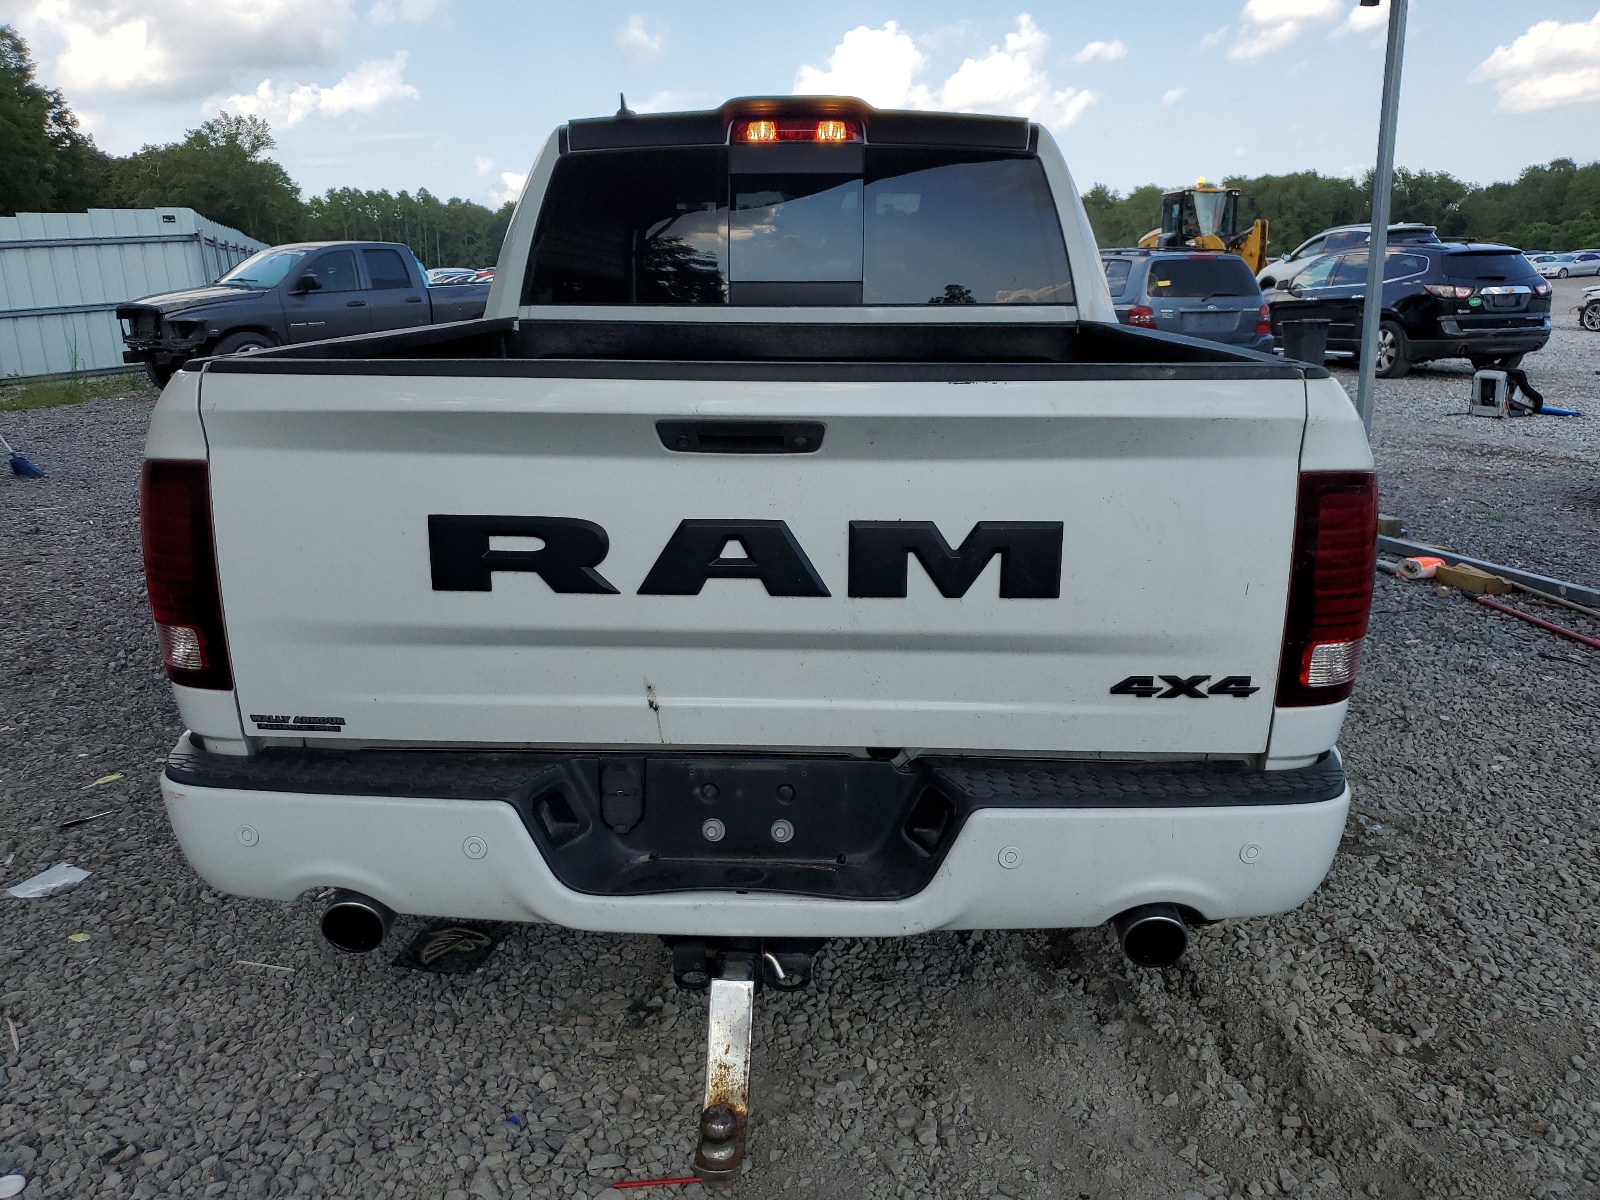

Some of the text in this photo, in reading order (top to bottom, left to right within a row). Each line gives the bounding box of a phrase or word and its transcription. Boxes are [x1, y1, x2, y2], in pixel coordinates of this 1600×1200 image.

[429, 514, 1063, 600] RAM
[1110, 674, 1260, 699] 4X4
[250, 714, 346, 725] WALLY ARMOUR
